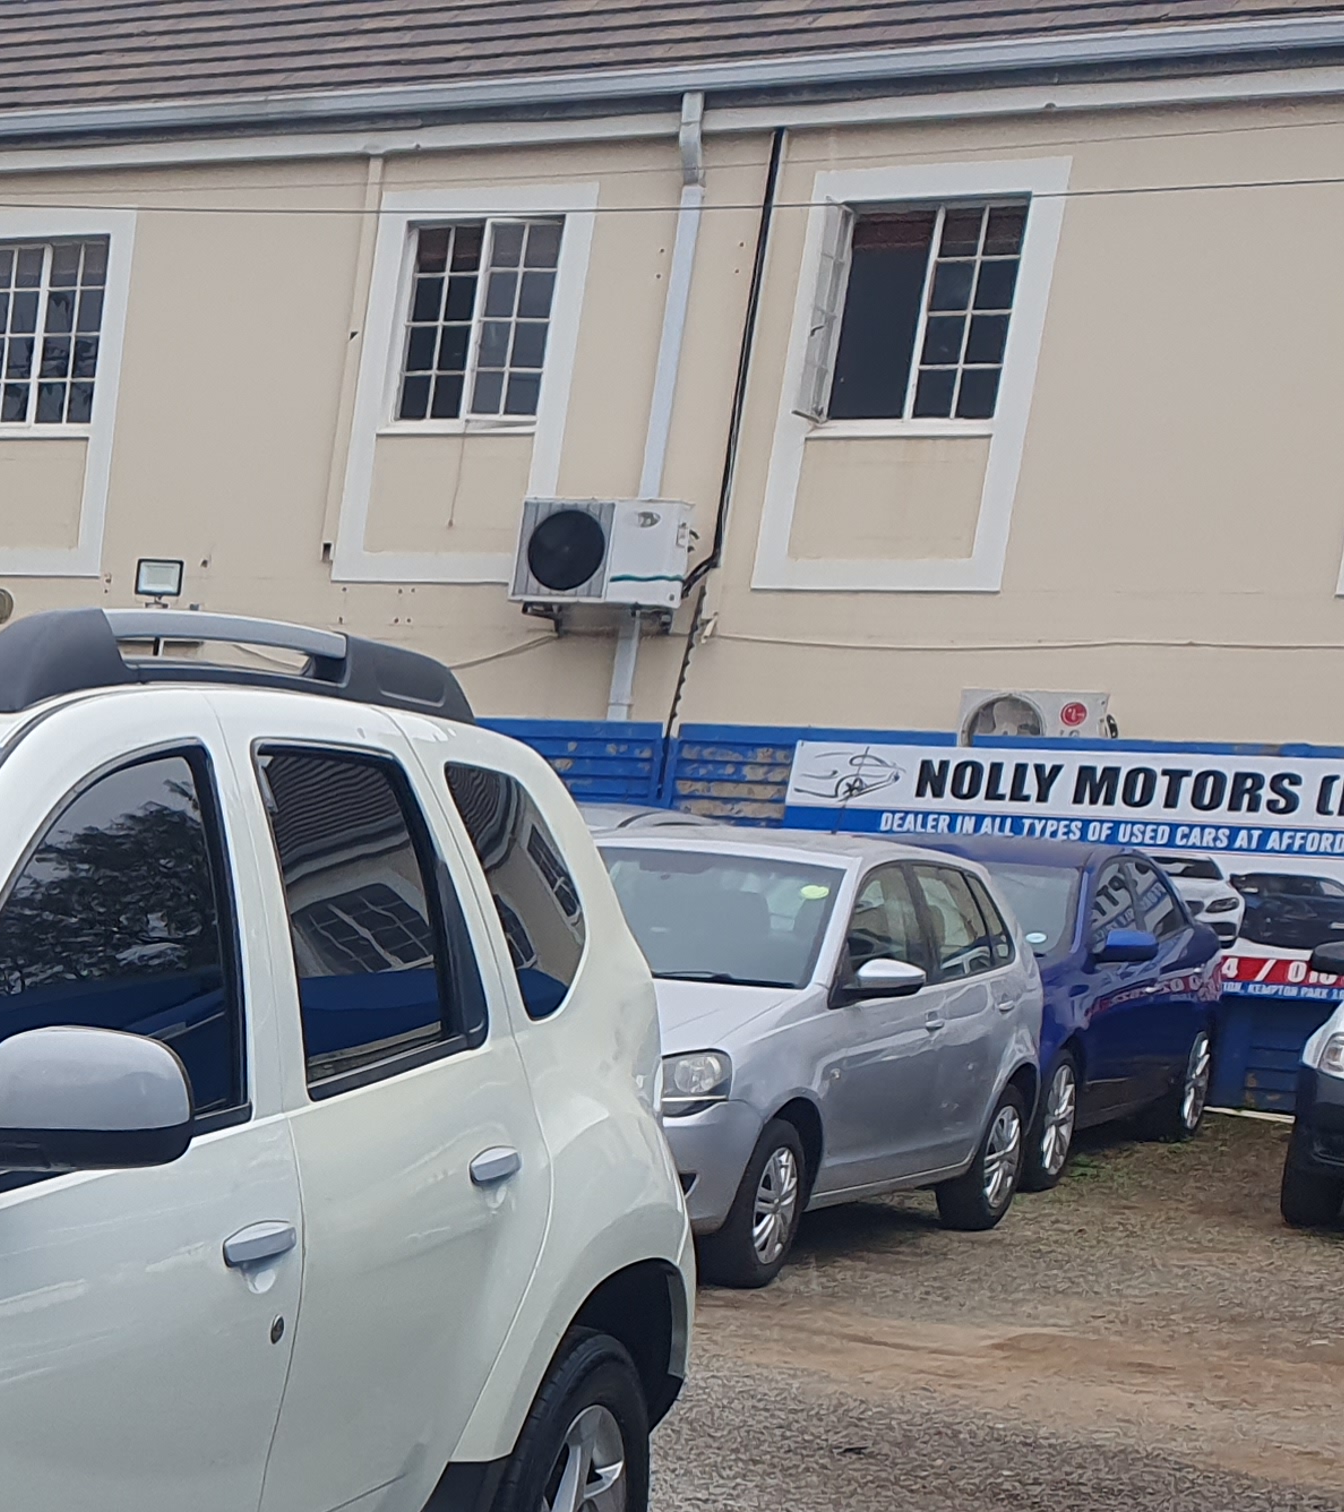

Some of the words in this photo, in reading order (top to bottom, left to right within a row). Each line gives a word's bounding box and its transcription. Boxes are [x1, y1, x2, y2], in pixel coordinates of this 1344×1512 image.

[915, 759, 1064, 803] NOLLY
[1072, 765, 1303, 815] MOTORS
[880, 812, 951, 834] DEALER
[955, 816, 971, 835] IN
[979, 817, 1015, 837] ALL
[1021, 818, 1082, 841] TYPES
[1087, 821, 1113, 842] OF
[1117, 823, 1170, 845] USED
[1175, 826, 1230, 847] CARS
[1234, 829, 1262, 850] AT
